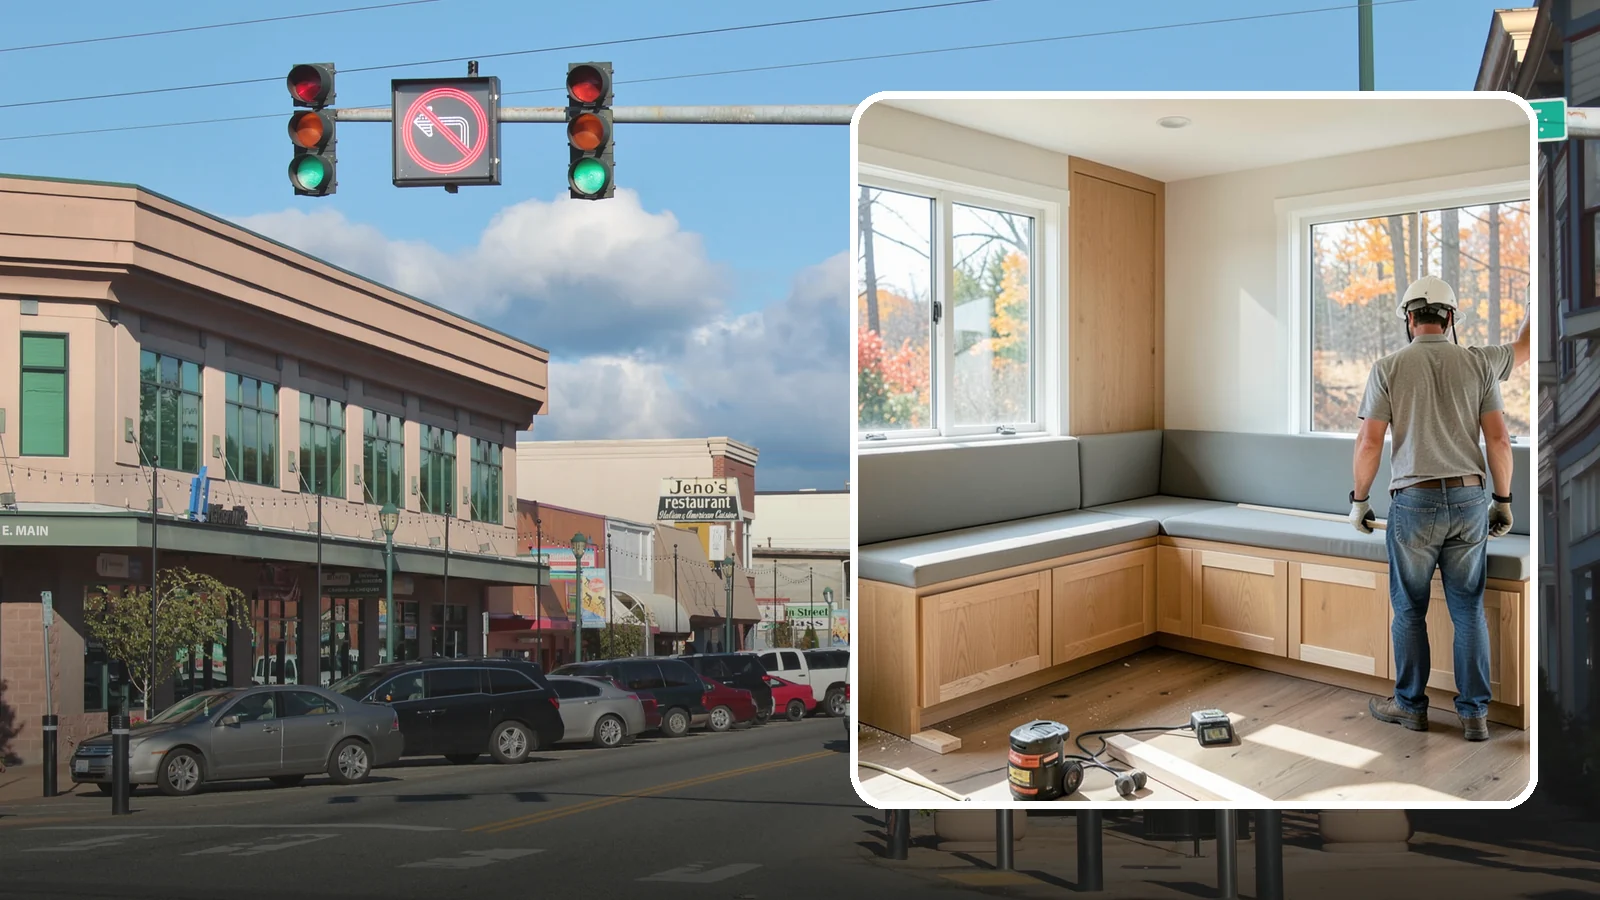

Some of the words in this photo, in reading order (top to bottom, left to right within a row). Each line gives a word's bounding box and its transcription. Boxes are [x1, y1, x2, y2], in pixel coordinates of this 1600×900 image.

[669, 480, 727, 494] Jeno's
[665, 496, 731, 508] restaurant
[658, 510, 681, 519] Italian
[686, 510, 714, 519] American
[715, 510, 737, 519] Cuisine
[2, 525, 13, 536] E.
[15, 525, 49, 536] MAIN
[797, 607, 828, 617] Street
